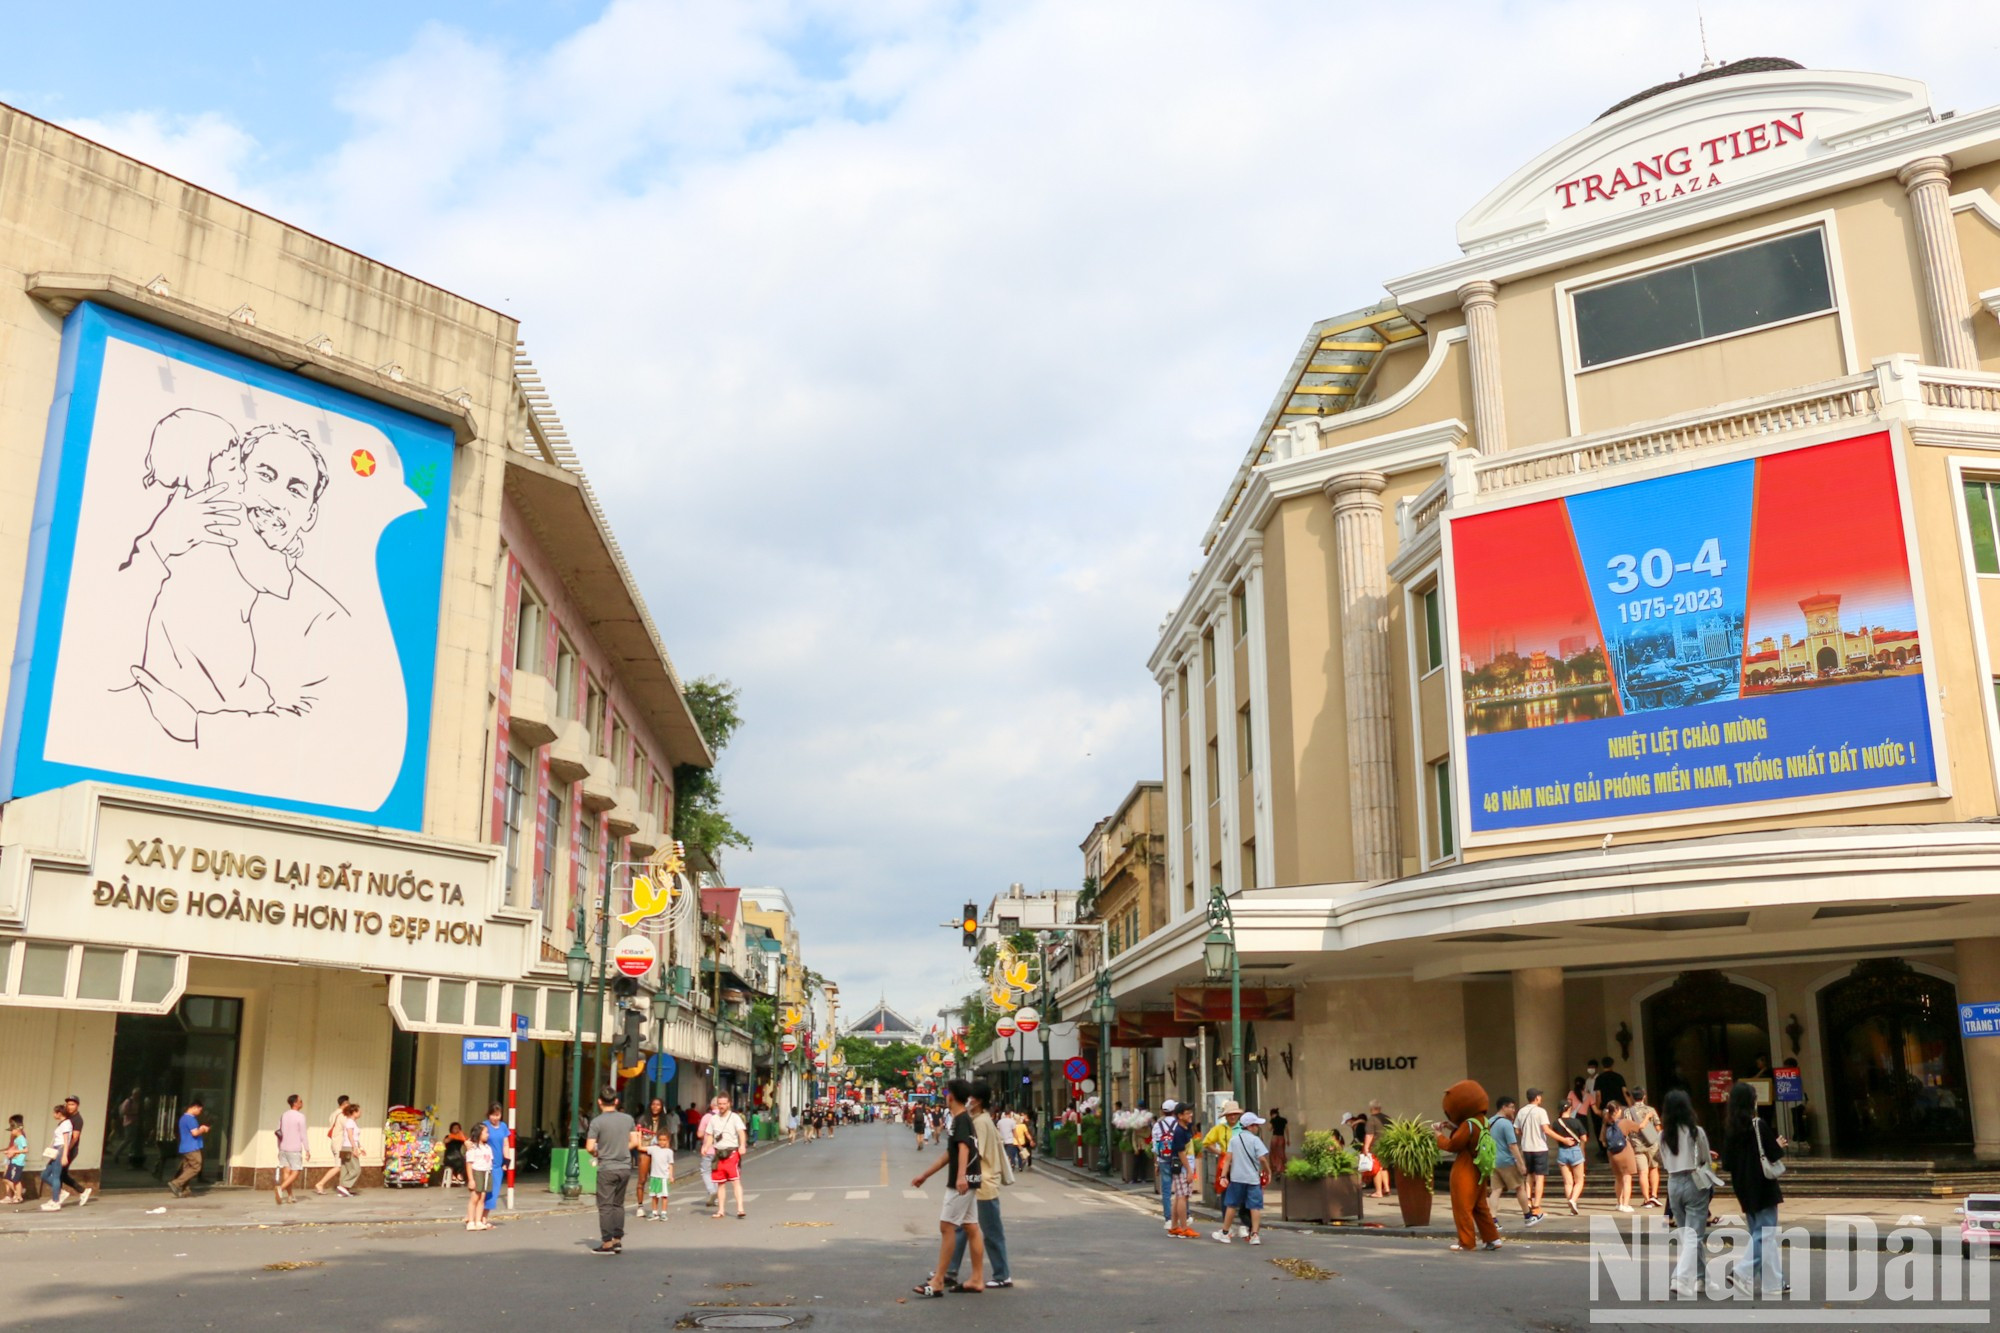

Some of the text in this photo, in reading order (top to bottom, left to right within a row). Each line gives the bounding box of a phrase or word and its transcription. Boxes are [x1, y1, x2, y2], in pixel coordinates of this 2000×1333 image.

[1555, 112, 1805, 209] TRANG TIEN
[1640, 173, 1721, 206] PLAZA
[1607, 537, 1727, 594] 30-4
[1618, 587, 1723, 624] 1975-2023
[1608, 715, 1768, 760] NHIỆT LIỆT CHÀO MỪNG
[1483, 792, 1499, 813] 48
[1502, 784, 1533, 811] NĂM
[1535, 779, 1570, 807] NGÀY
[1573, 771, 1601, 803] GIẢI
[1604, 771, 1651, 800] PHÓNG
[1653, 762, 1690, 794] MIỀN
[1693, 764, 1732, 789] NAM,
[1734, 752, 1784, 785] THỐNG
[1786, 745, 1825, 778] NHẤT
[1829, 741, 1858, 774] ĐẤT
[1862, 737, 1906, 769] NƯỚC
[125, 837, 465, 907] XÂY DỰNG LẠI ĐẤT NƯỚC TA
[93, 874, 483, 947] ĐÀNG HOÀNG HƠN TO ĐẸP HƠN
[1965, 1018, 1993, 1032] TRÀNG
[1349, 1056, 1418, 1071] HUBLOT
[1775, 1071, 1797, 1080] SALE
